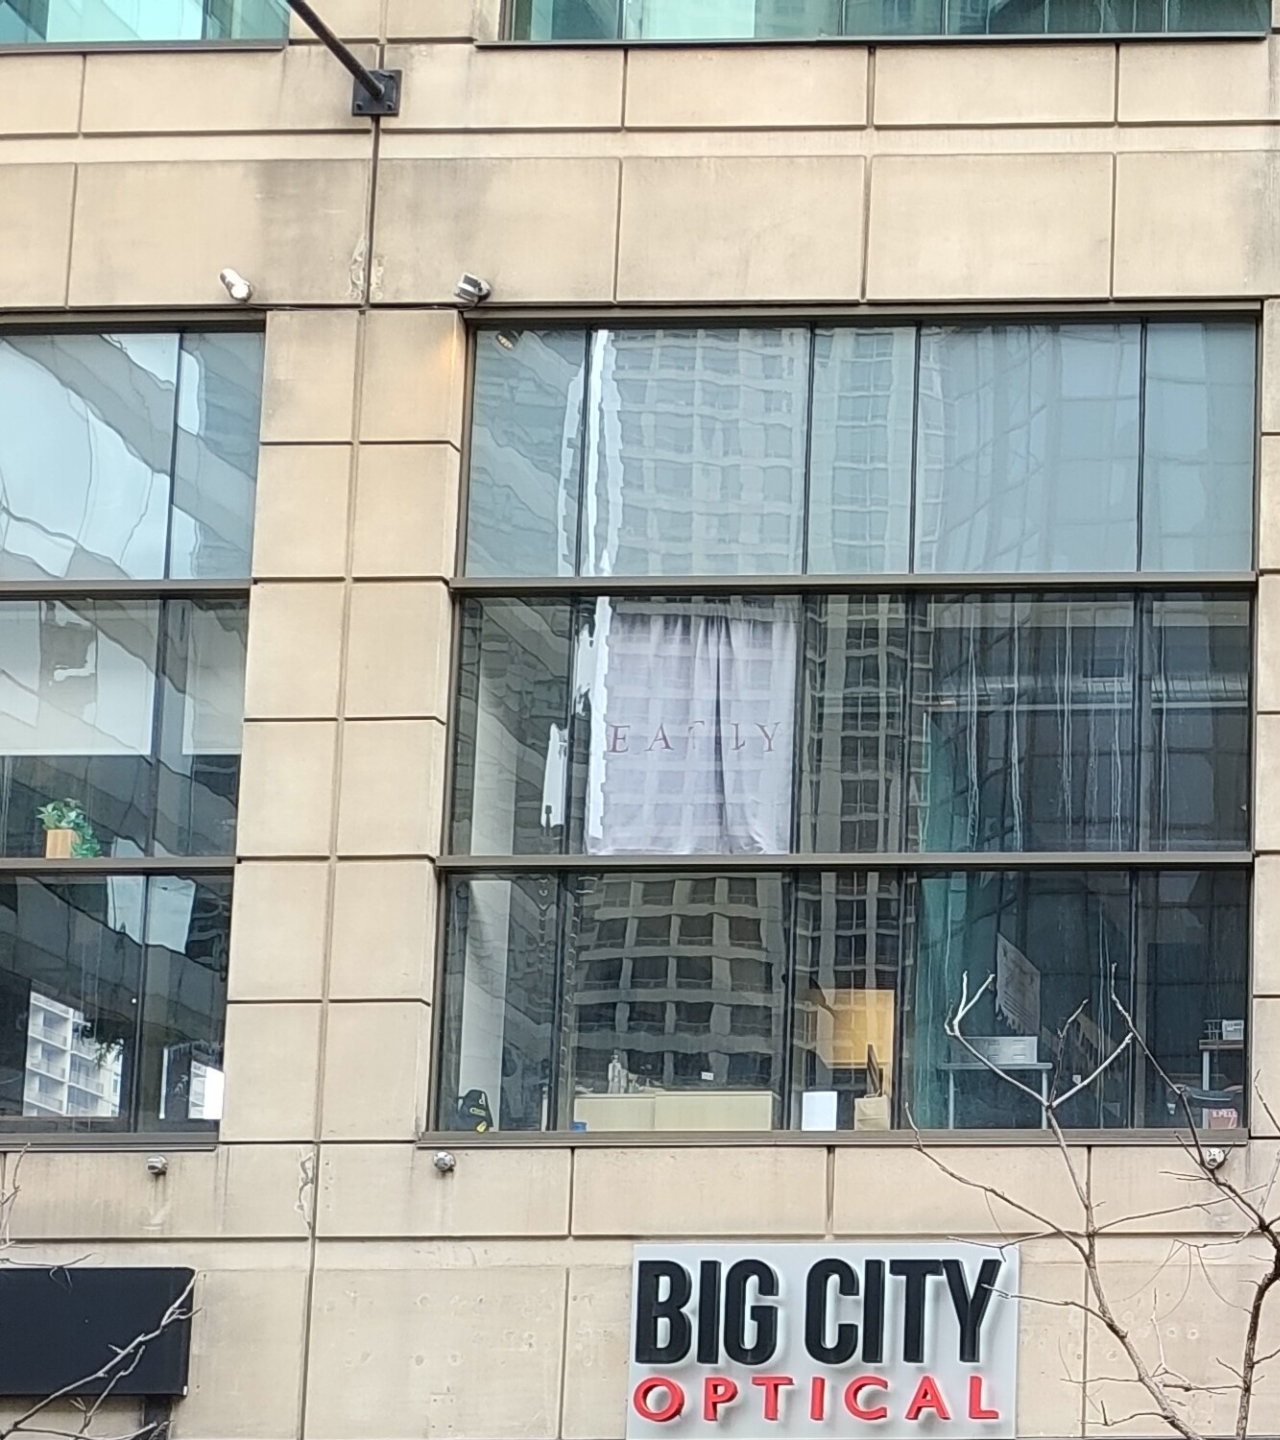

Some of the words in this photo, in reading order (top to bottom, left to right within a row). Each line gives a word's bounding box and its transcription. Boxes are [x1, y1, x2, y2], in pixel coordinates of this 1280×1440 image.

[634, 1258, 779, 1366] BIG
[804, 1257, 1002, 1365] CITY
[632, 1375, 1000, 1422] OPTICAL
